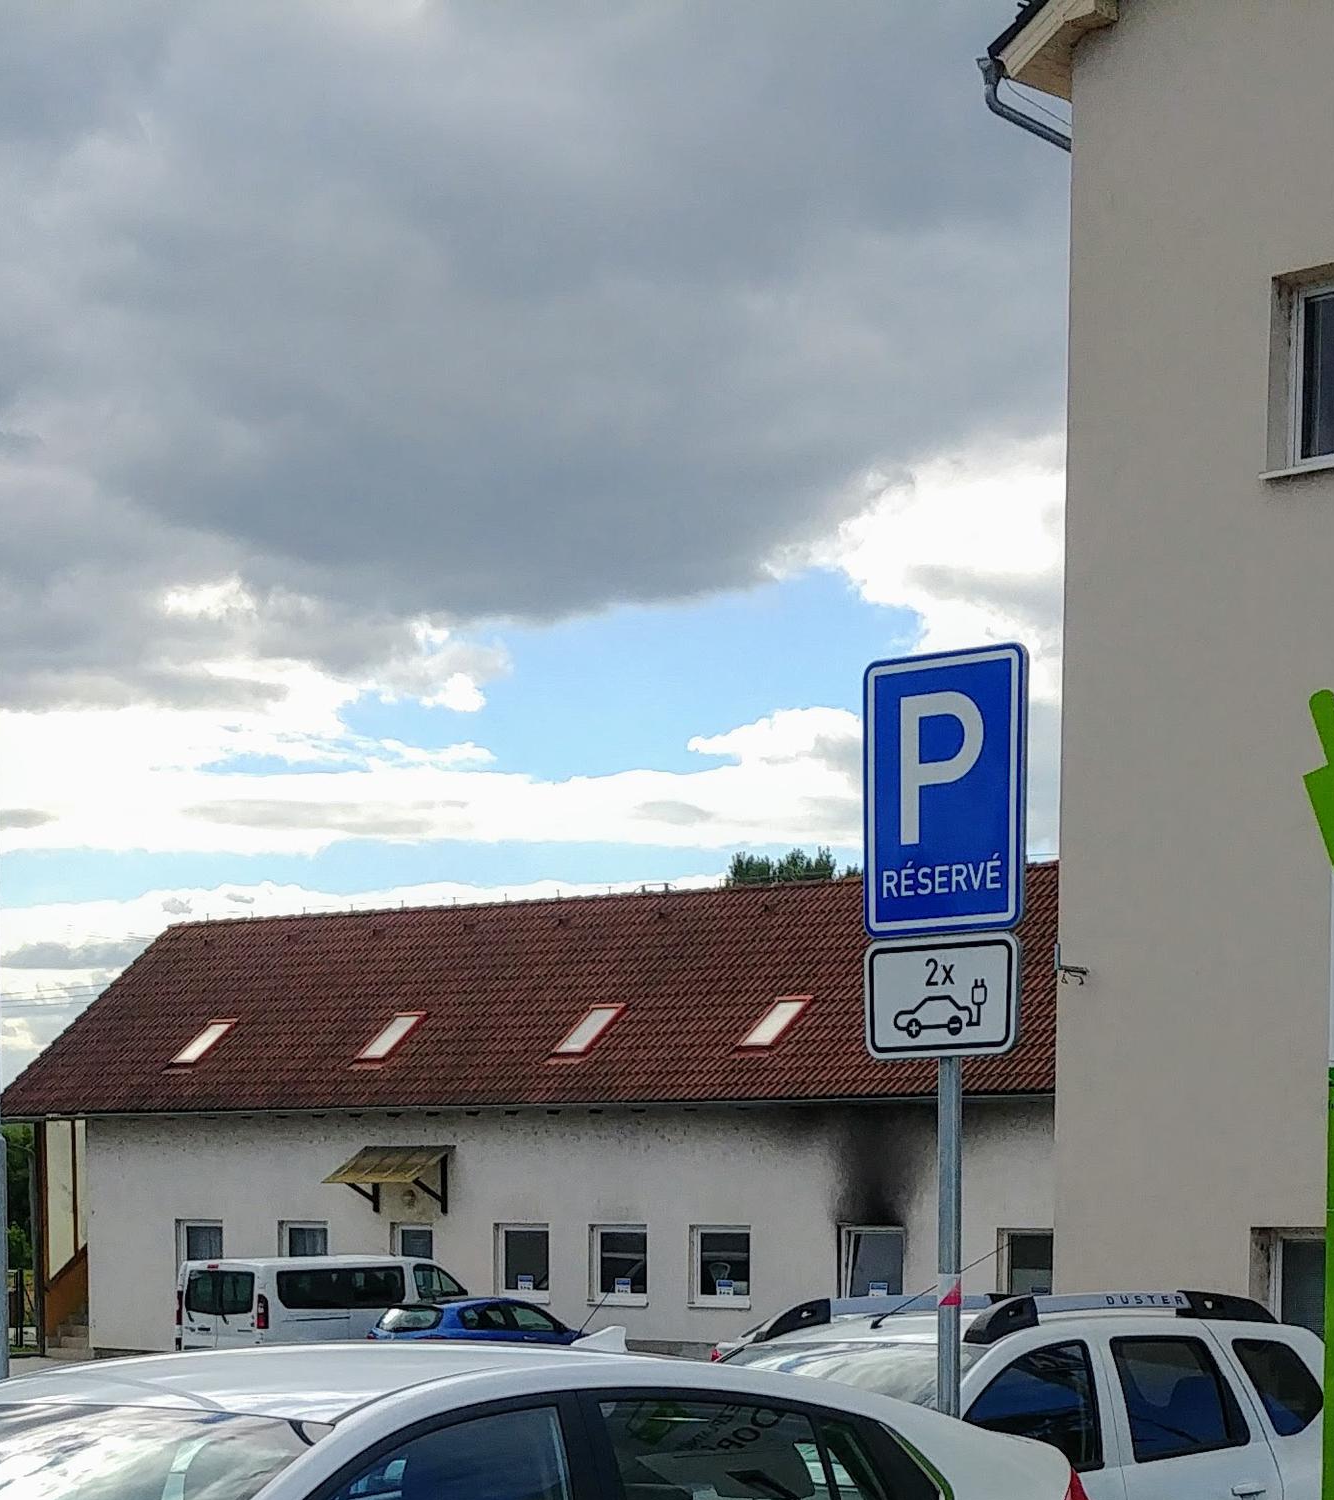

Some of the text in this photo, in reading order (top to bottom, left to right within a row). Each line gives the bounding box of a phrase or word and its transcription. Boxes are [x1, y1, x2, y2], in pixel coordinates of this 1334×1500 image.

[899, 690, 985, 846] P
[881, 851, 1003, 899] RÉSERVÉ
[924, 957, 956, 988] 2x
[1105, 1294, 1185, 1305] DUSTER
